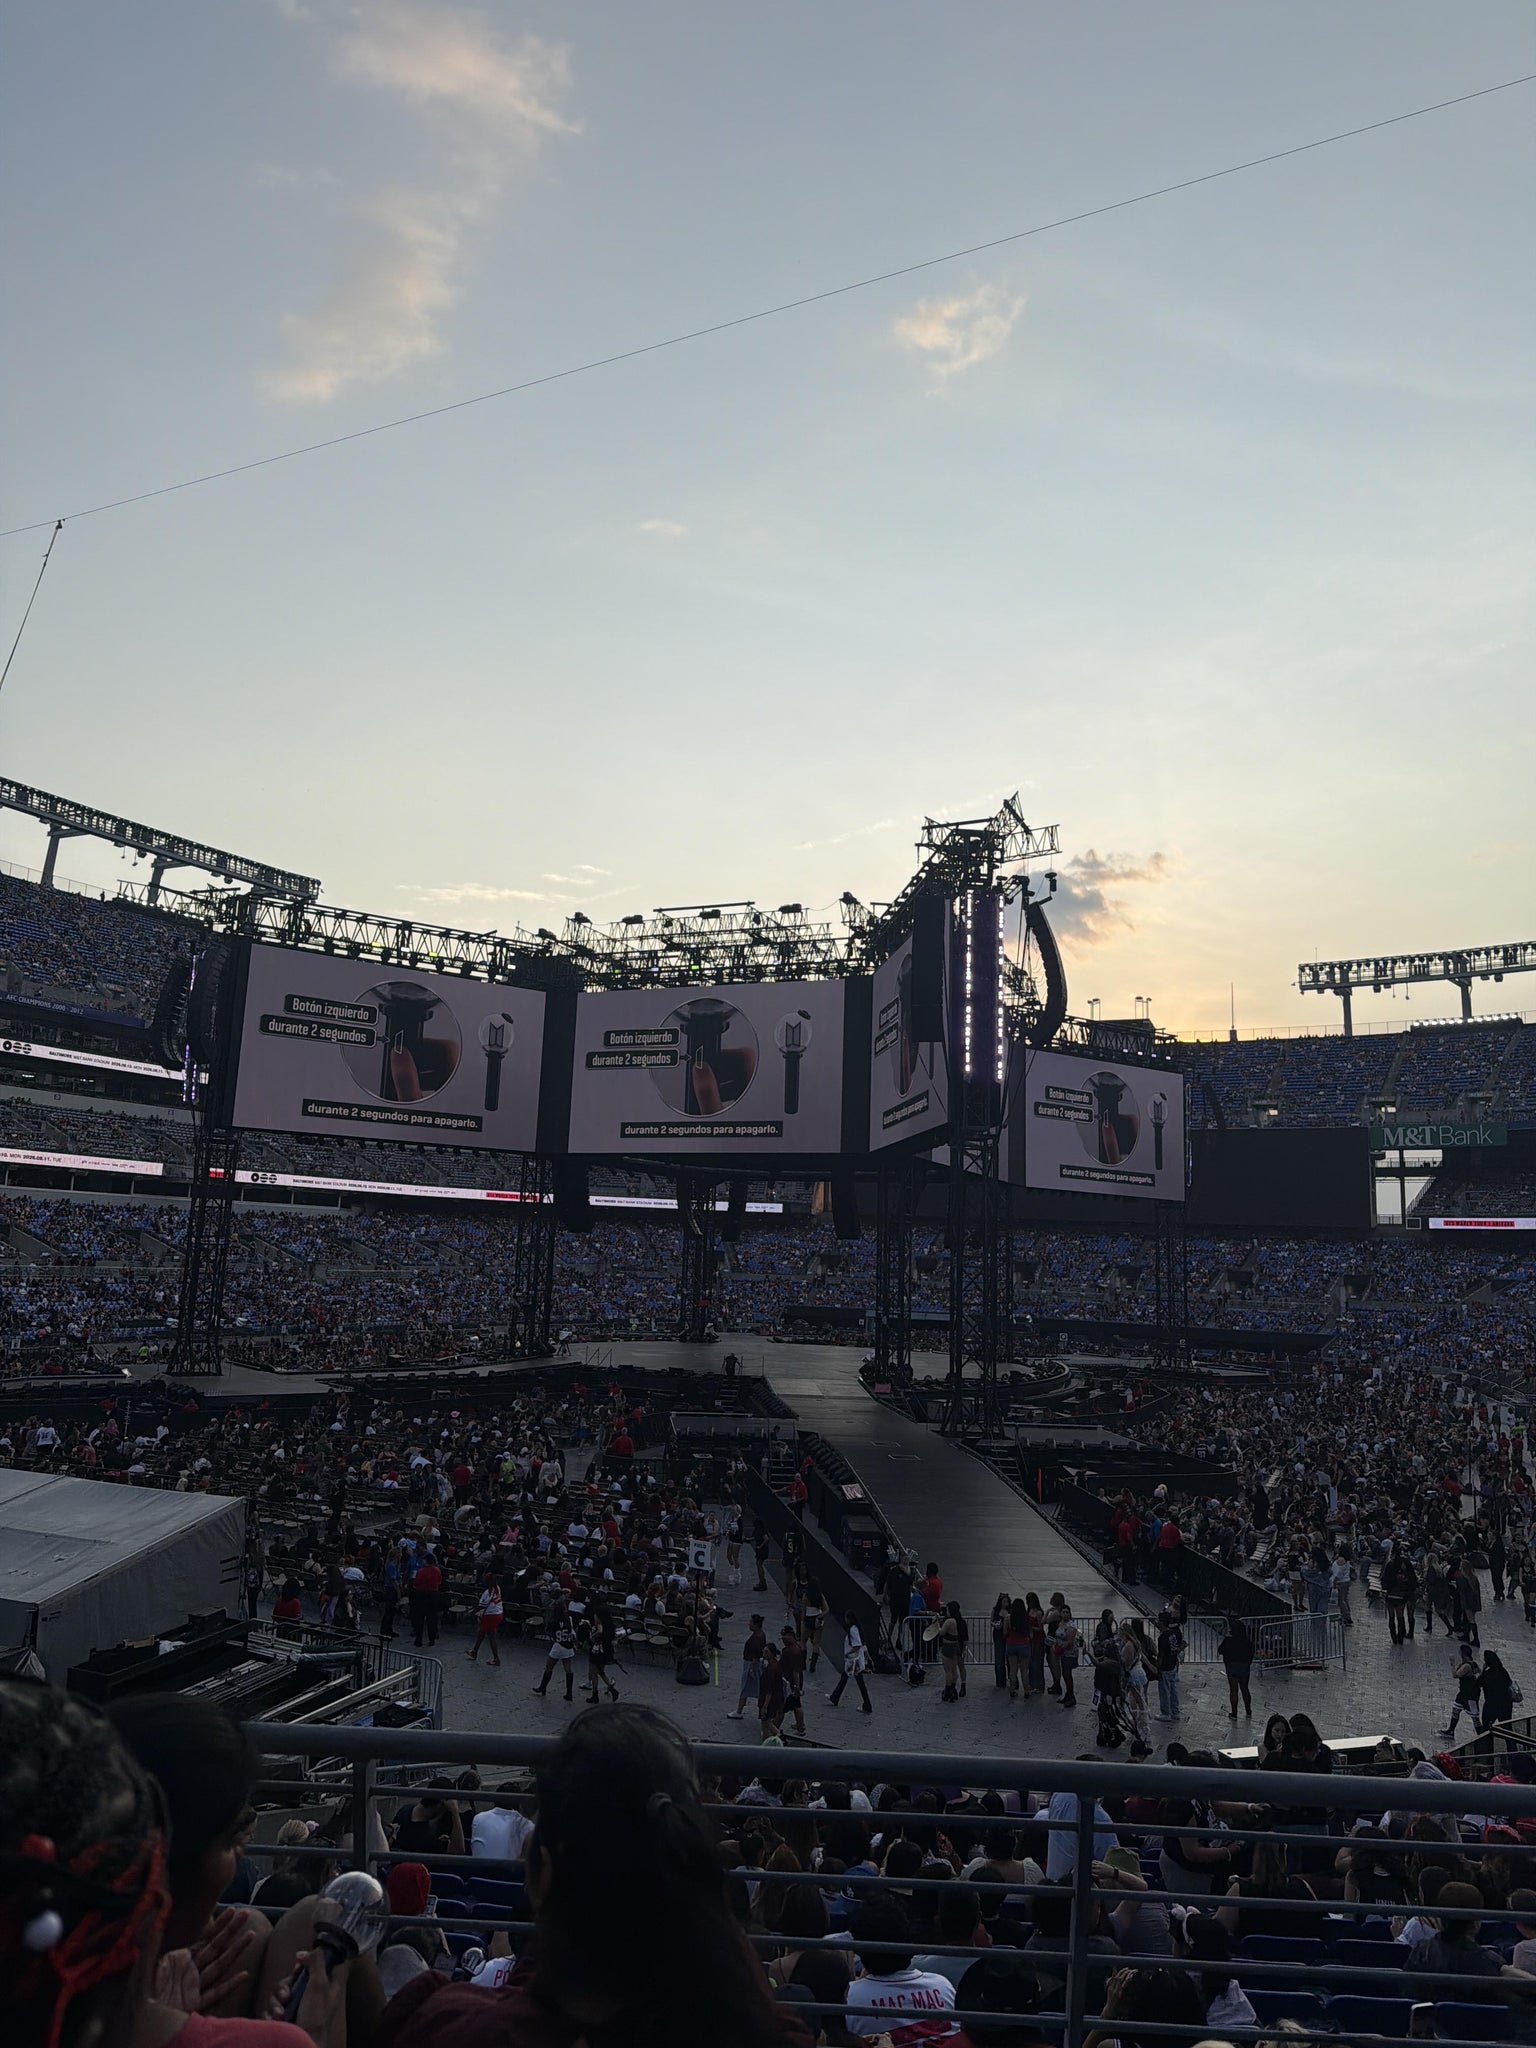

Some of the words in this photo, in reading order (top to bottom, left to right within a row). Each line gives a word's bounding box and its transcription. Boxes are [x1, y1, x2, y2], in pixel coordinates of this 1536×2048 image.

[6, 994, 17, 1002] AFC
[18, 996, 51, 1008] CHAMPIONS
[292, 998, 322, 1014] Botón
[324, 1002, 369, 1020] izquierdo
[268, 1018, 308, 1035] durante
[311, 1024, 318, 1036] 2
[320, 1027, 366, 1042] segundos
[610, 1032, 633, 1044] Botón
[635, 1032, 672, 1046] izquierdo
[592, 1054, 624, 1066] durante
[625, 1054, 630, 1064] 2
[632, 1053, 671, 1068] segundos
[1065, 1090, 1089, 1103] izquierdo
[308, 1104, 350, 1116] durante
[351, 1107, 358, 1116] 2
[360, 1110, 408, 1122] segundos
[411, 1115, 432, 1124] para
[434, 1116, 478, 1128] apagarlo.
[1038, 1105, 1059, 1116] durante
[1060, 1107, 1064, 1117] 2
[1064, 1109, 1089, 1120] segundos
[625, 1126, 659, 1134] durante
[660, 1126, 667, 1134] 2
[668, 1125, 712, 1136] segundos
[713, 1126, 734, 1136] para
[735, 1124, 778, 1136] apagarlo.
[1382, 1126, 1436, 1147] M&T
[1440, 1125, 1492, 1145] Bank
[1062, 1168, 1084, 1176] durante
[1090, 1171, 1116, 1179] segundos
[694, 1551, 705, 1567] C
[910, 1988, 944, 2009] MAC
